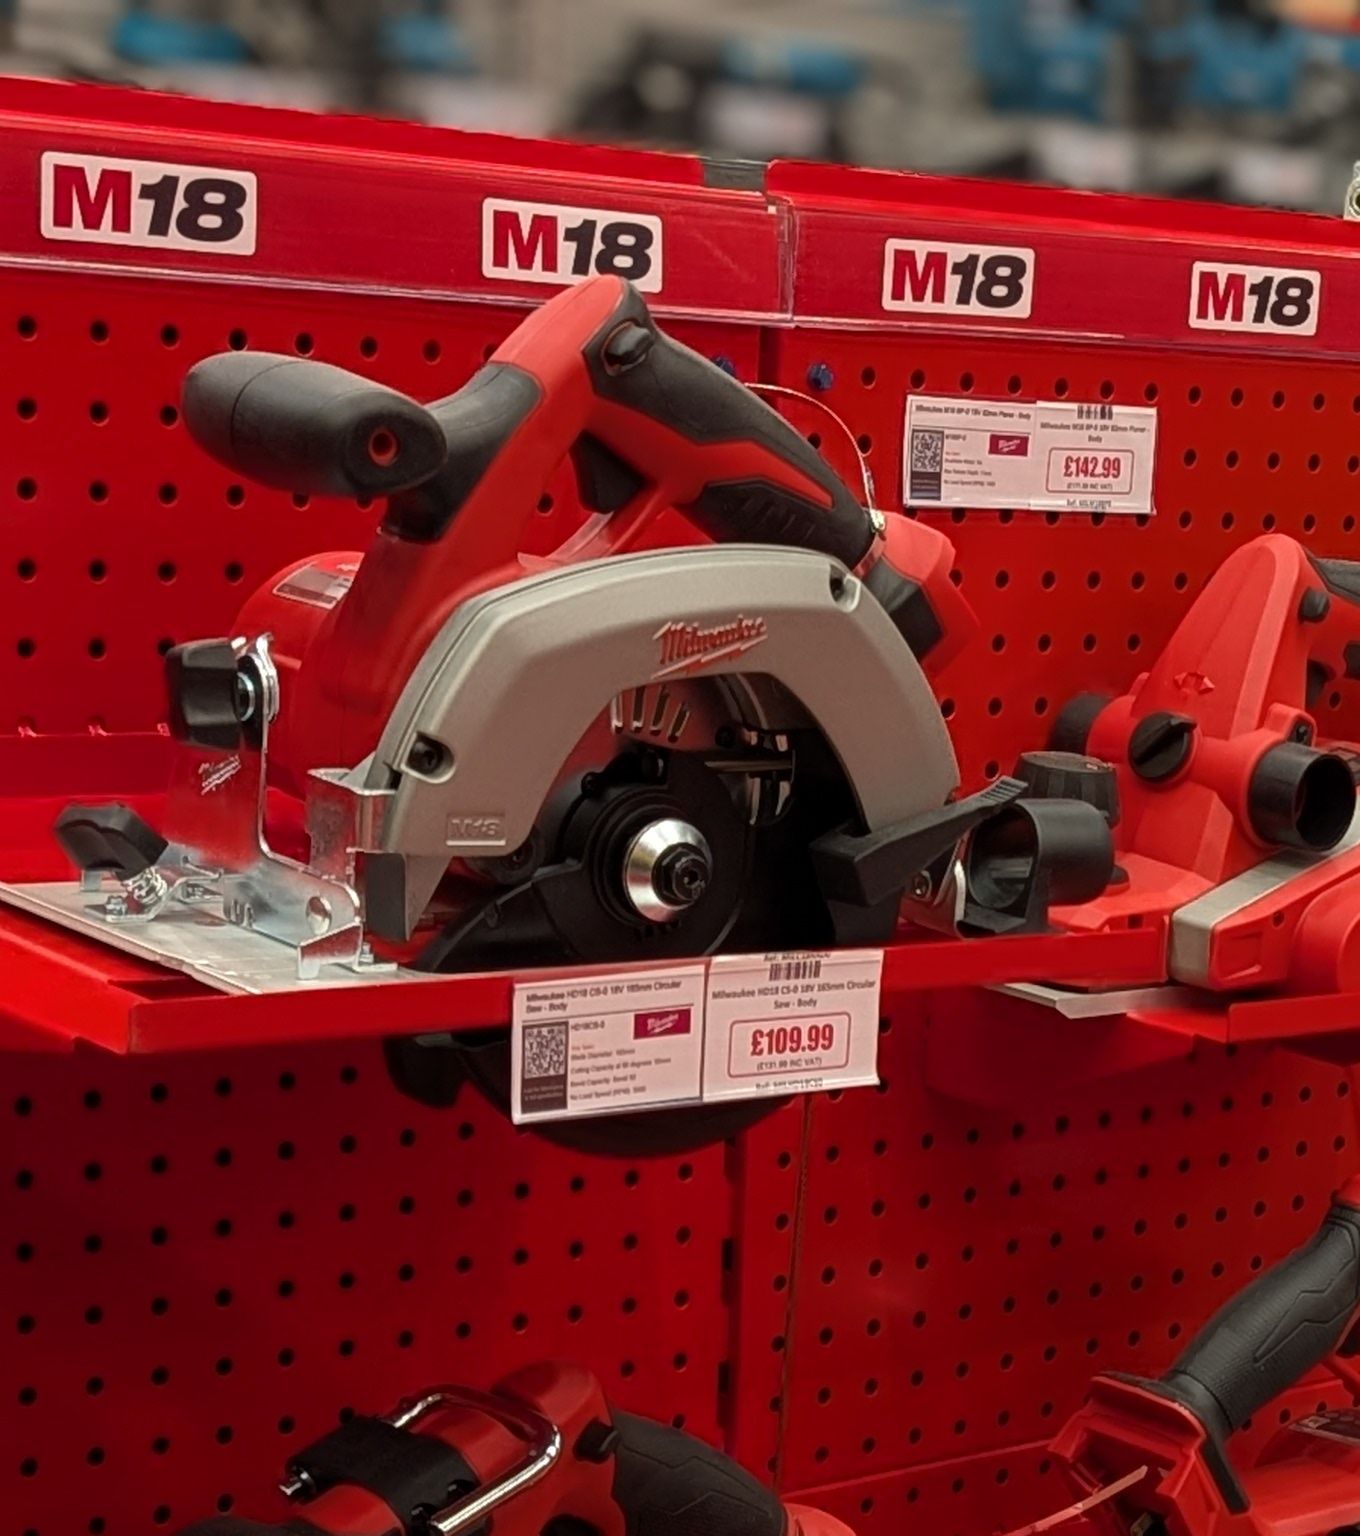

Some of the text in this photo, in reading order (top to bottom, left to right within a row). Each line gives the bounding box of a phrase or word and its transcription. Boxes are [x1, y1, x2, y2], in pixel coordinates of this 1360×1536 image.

[52, 165, 247, 242] M18
[494, 209, 653, 279] M18
[891, 250, 1026, 307] M18
[1199, 270, 1313, 327] M18
[1064, 456, 1121, 478] £142.99
[653, 614, 767, 664] Milwaukee
[712, 989, 755, 1000] Milwaukee
[847, 980, 876, 992] Circular
[774, 998, 817, 1010] Saw Body
[751, 1024, 834, 1056] £109.99
